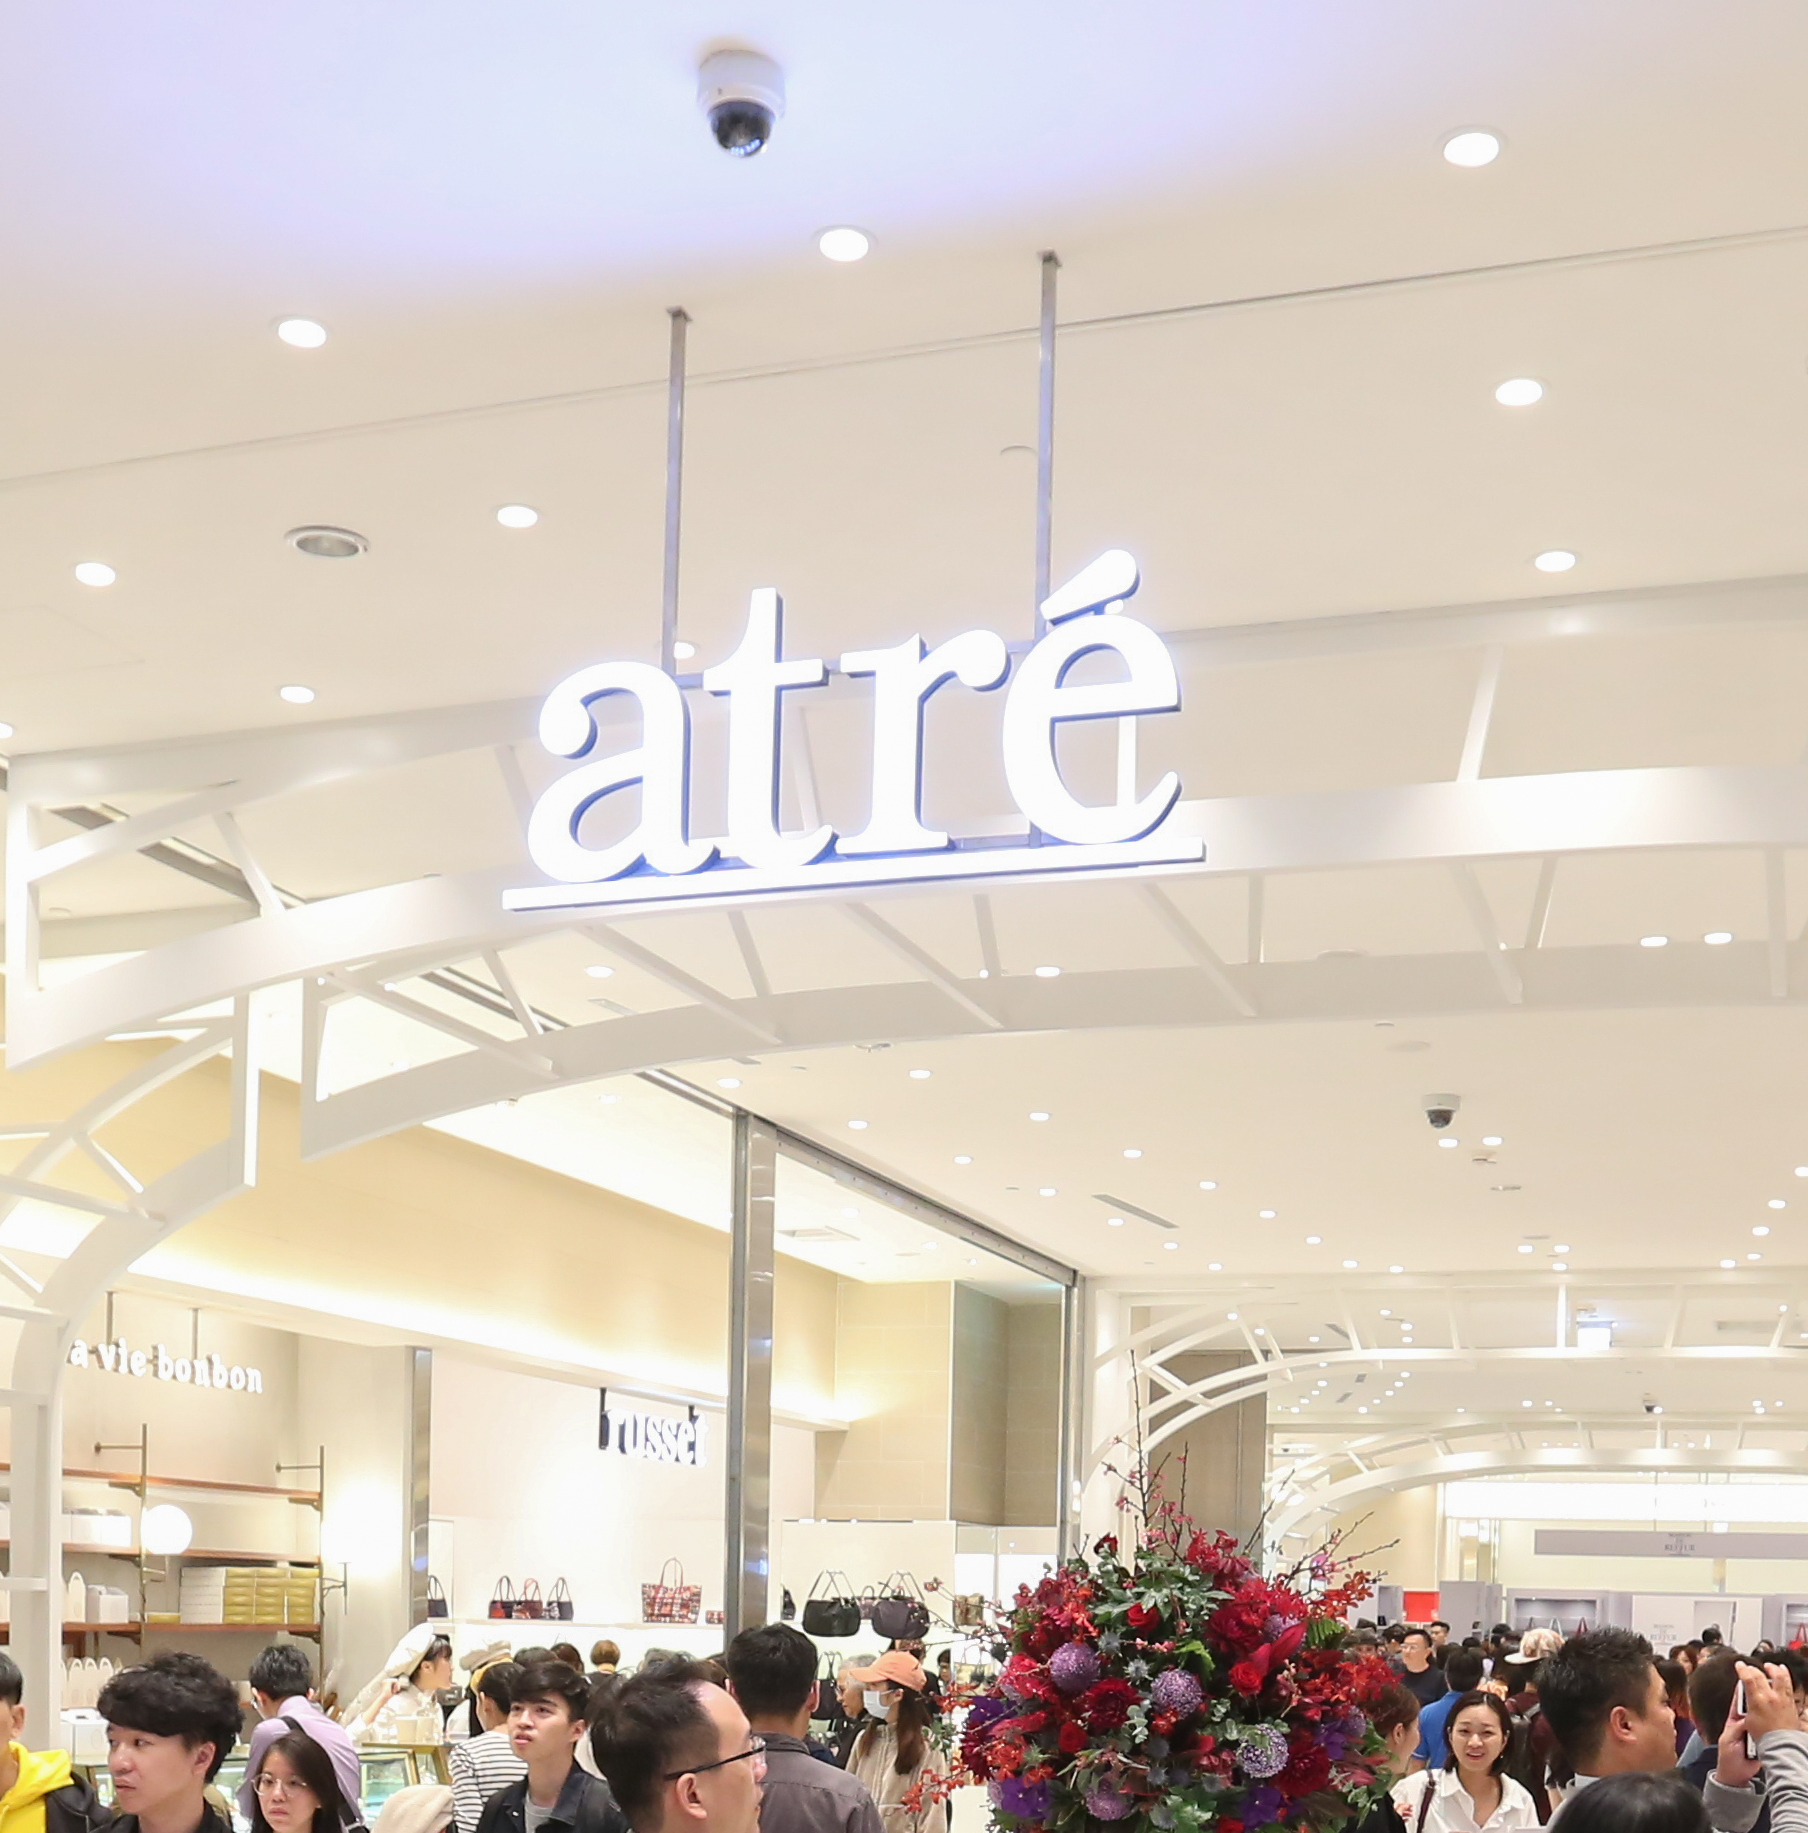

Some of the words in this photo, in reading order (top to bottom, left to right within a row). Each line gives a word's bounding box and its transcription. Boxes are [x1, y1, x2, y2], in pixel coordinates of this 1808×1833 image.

[526, 548, 1183, 883] atré
[97, 1337, 147, 1377] vie
[154, 1343, 263, 1394] bonbon
[599, 1408, 710, 1468] russet
